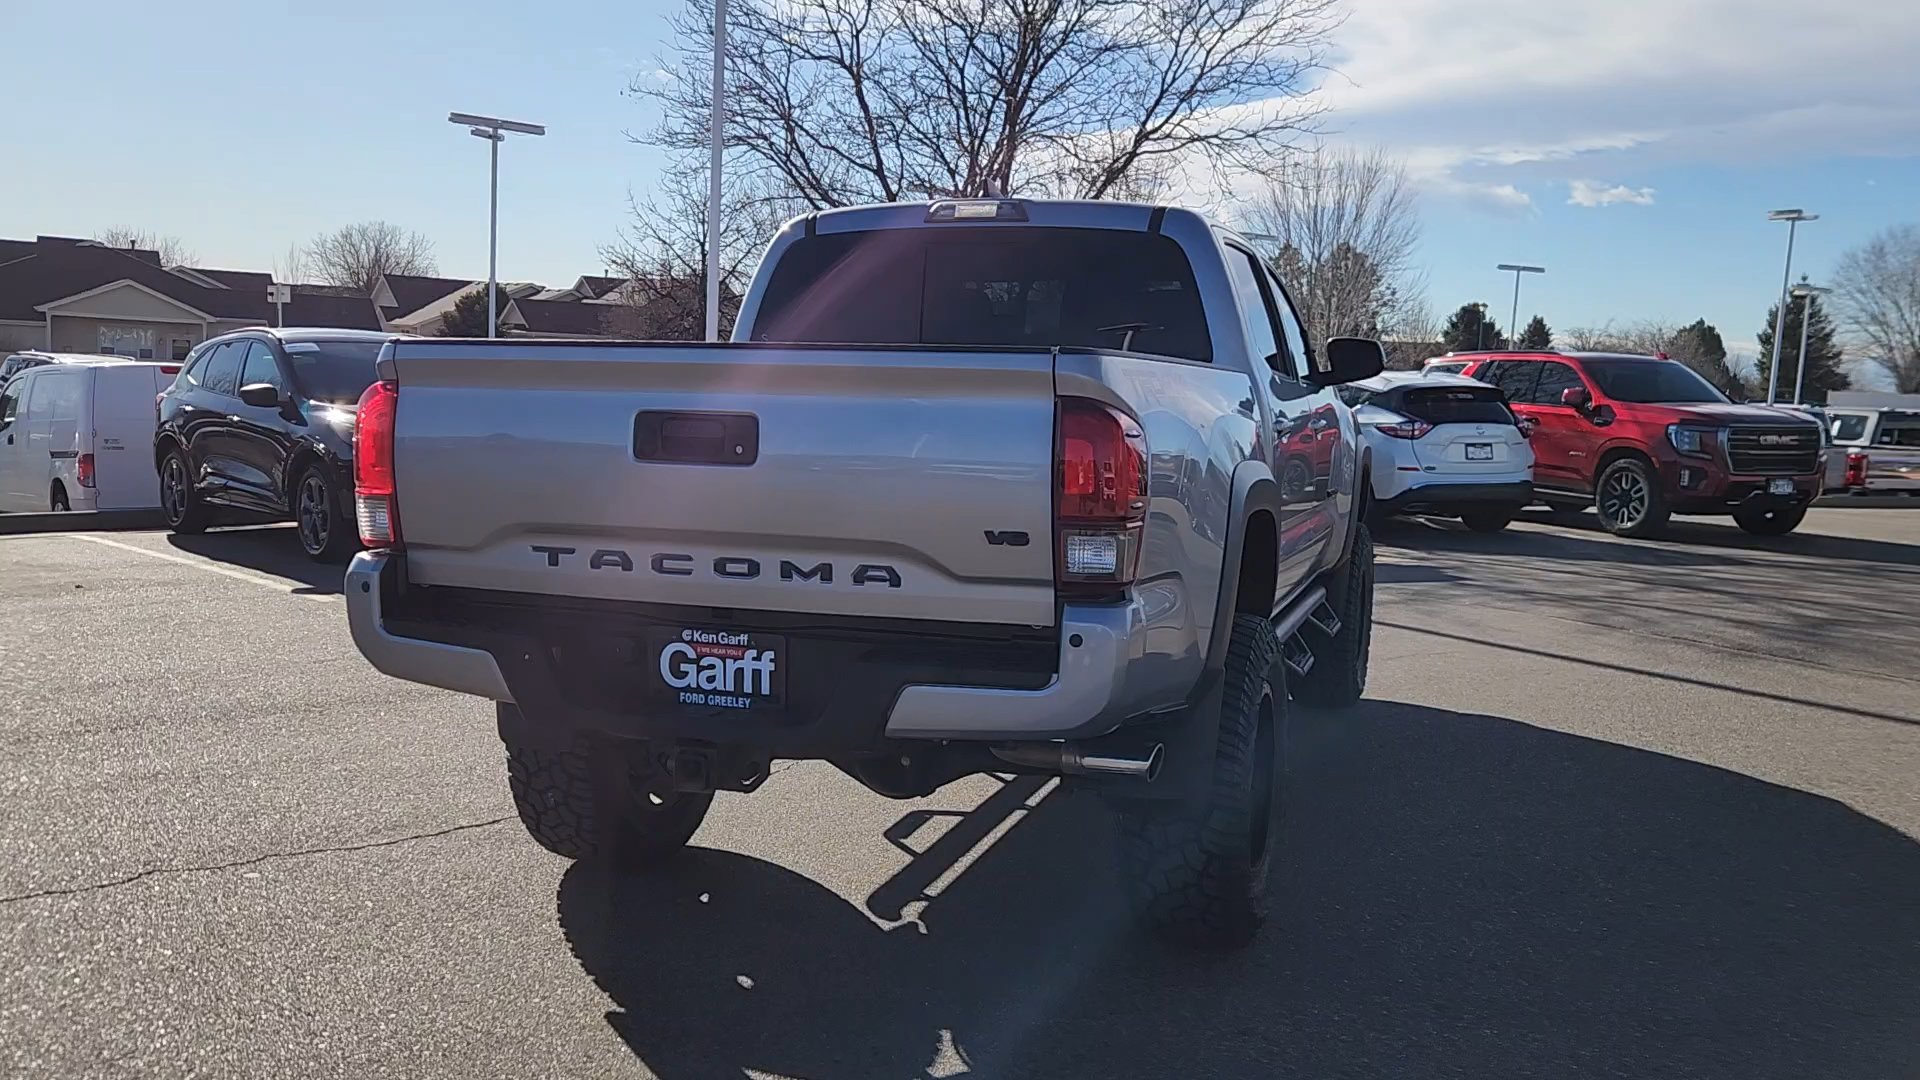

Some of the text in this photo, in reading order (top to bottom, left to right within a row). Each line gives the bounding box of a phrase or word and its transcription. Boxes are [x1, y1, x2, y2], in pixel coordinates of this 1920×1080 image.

[1759, 435, 1799, 445] GMC
[530, 544, 902, 588] TACOMA
[693, 630, 749, 646] Ken Garff
[711, 647, 726, 655] HEAR
[660, 642, 775, 695] Garff
[680, 692, 751, 709] FORD GREELEY
